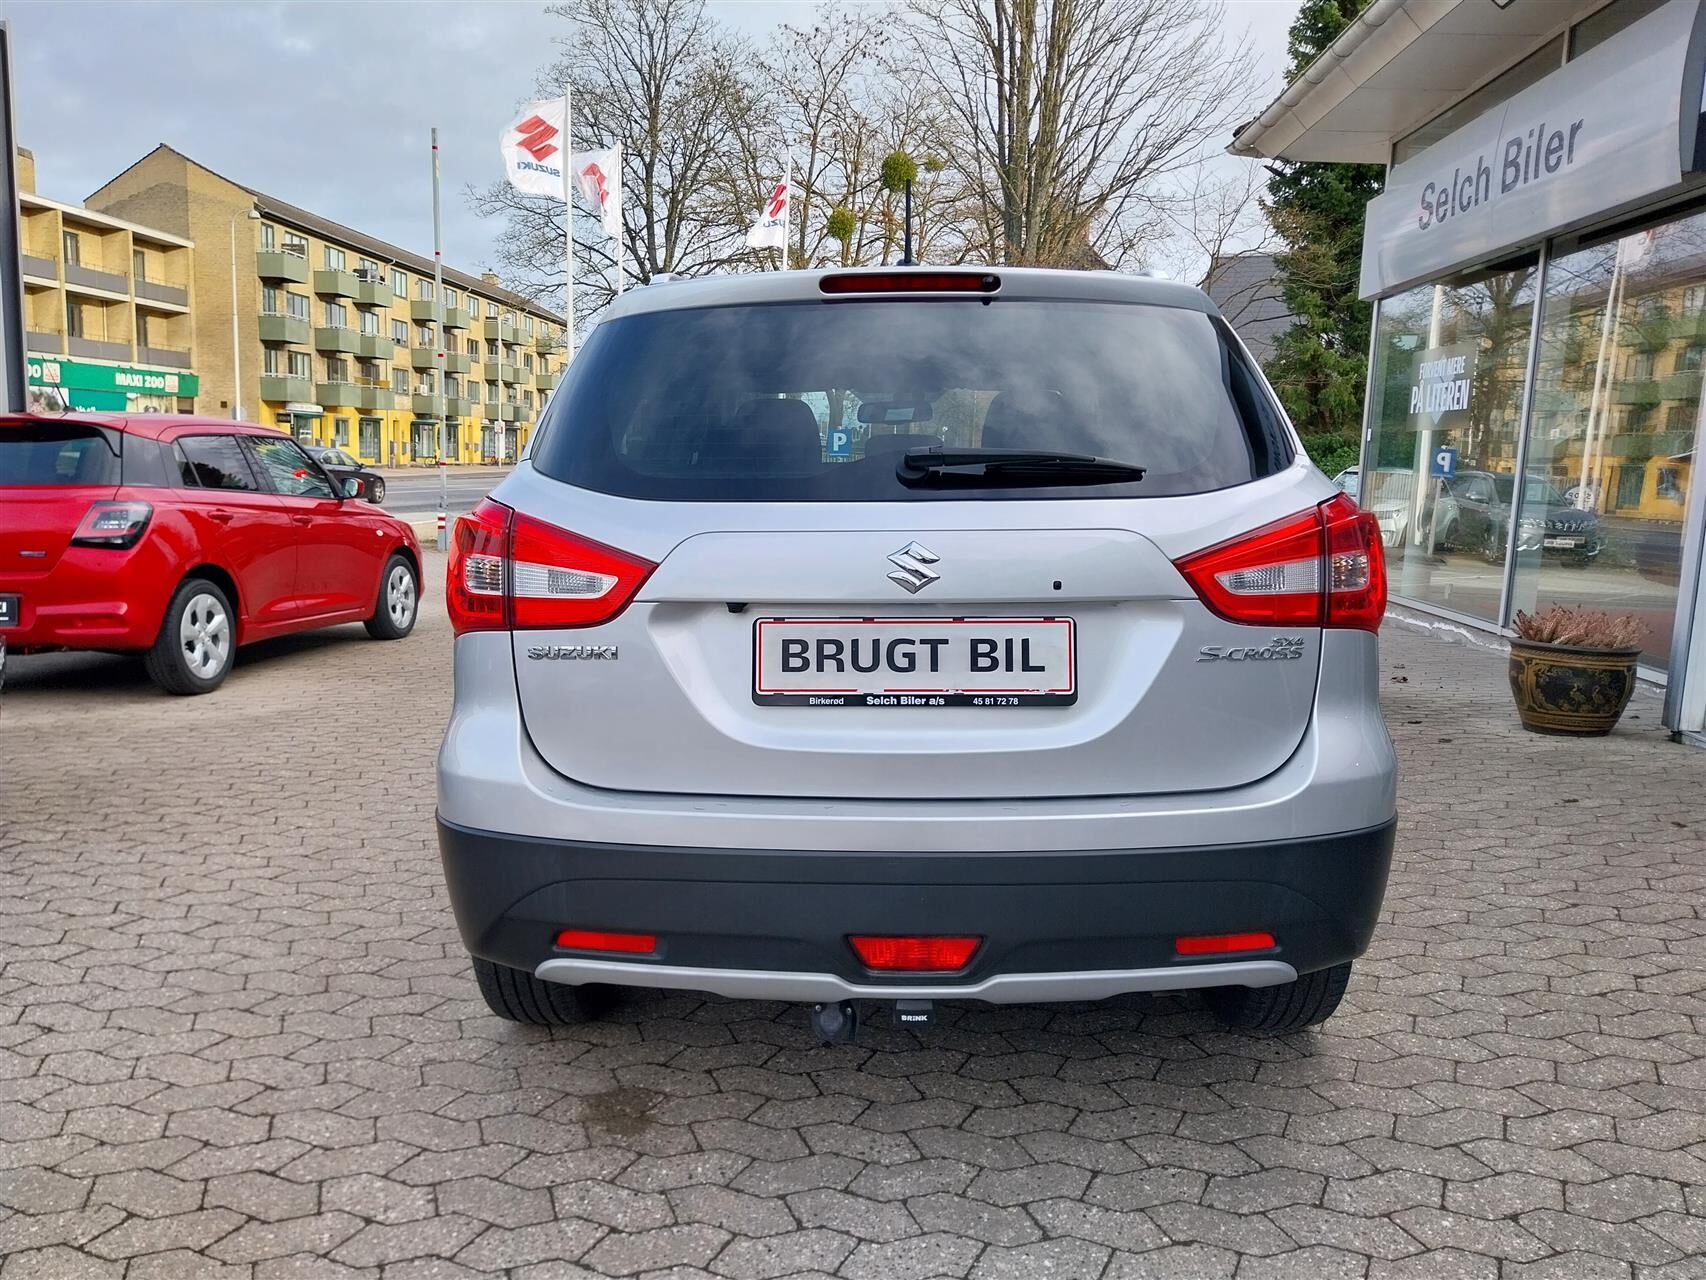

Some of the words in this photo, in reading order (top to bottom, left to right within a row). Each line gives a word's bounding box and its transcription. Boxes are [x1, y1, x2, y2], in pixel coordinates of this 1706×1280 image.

[1418, 155, 1492, 231] Selch
[1501, 118, 1585, 194] Biler
[115, 372, 143, 387] MAXI
[144, 375, 164, 389] ZOO
[1410, 379, 1425, 414] PÅ
[833, 432, 848, 451] P
[1271, 636, 1304, 647] SX4
[527, 645, 618, 661] SUZUKI
[781, 638, 949, 673] BRUGT
[970, 638, 1046, 673] BIL
[809, 697, 844, 705] Birkerød
[866, 696, 897, 705] Selch
[900, 696, 926, 705] Biler
[929, 696, 945, 705] a/s
[973, 697, 983, 705] 45
[984, 697, 994, 705] 81
[996, 697, 1006, 705] 72
[1008, 697, 1019, 705] 78
